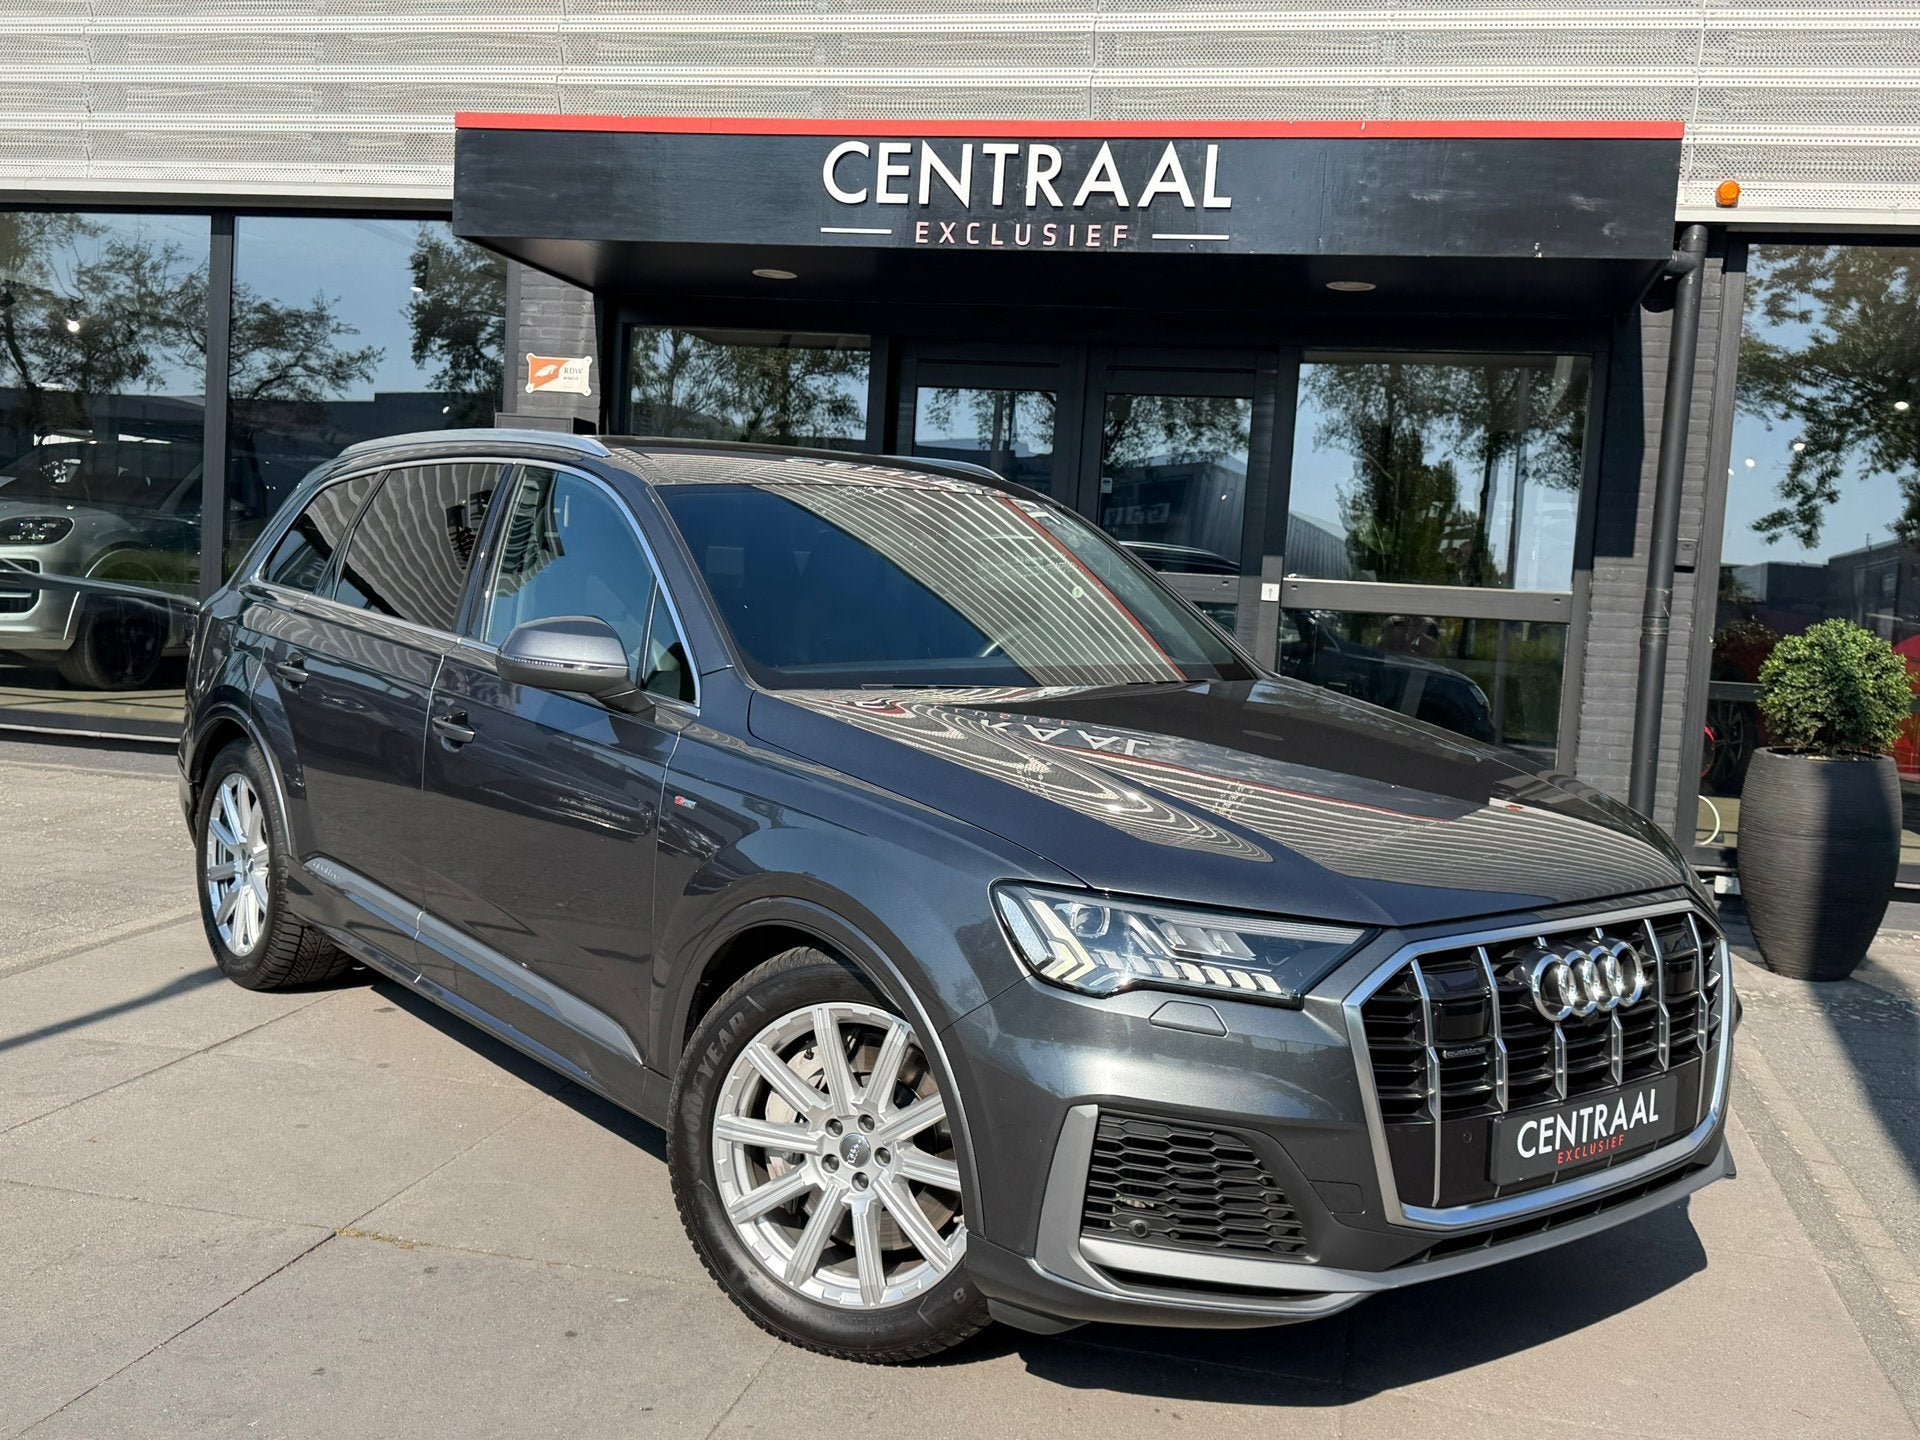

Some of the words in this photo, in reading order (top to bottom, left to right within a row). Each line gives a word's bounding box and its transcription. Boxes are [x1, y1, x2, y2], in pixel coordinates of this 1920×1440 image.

[822, 139, 1232, 209] CENTRAAL
[914, 221, 1130, 248] EXCLUSIEF
[563, 367, 584, 375] RDW
[1517, 1088, 1659, 1159] CENTRAAL
[1557, 1134, 1626, 1166] EXCLUSIEF
